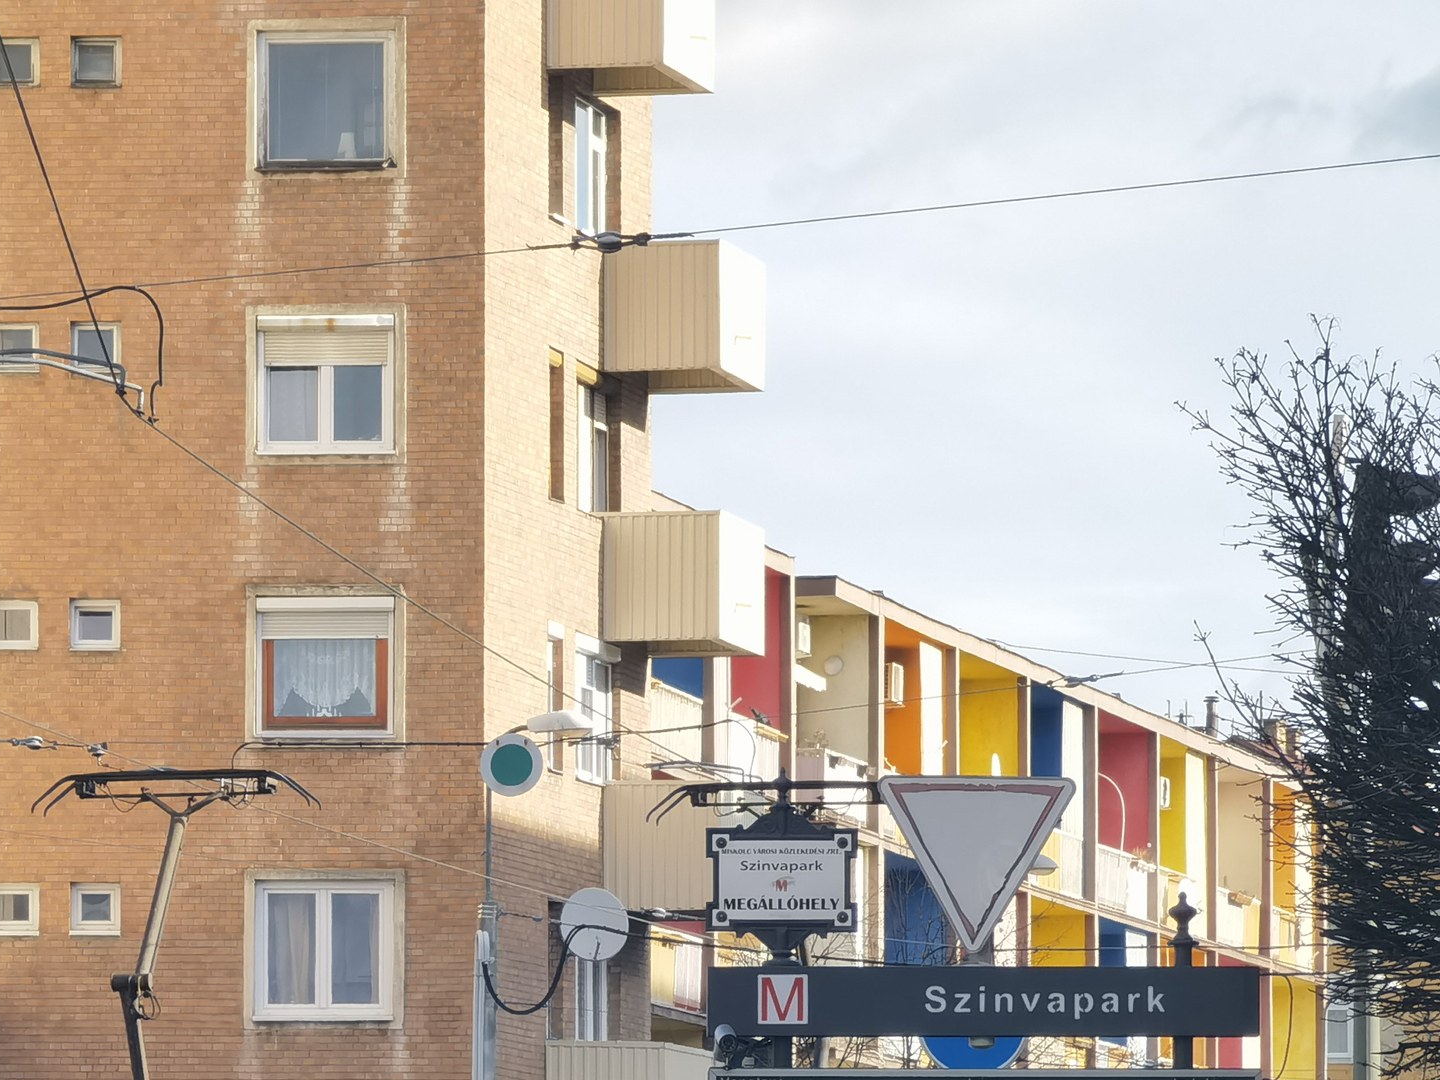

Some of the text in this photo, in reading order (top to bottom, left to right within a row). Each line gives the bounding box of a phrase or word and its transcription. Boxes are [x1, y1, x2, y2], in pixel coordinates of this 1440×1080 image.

[740, 860, 824, 873] Szinvapark
[723, 895, 840, 911] MEGÁLLÓHELY
[760, 976, 1166, 1022] M Szinvapark
